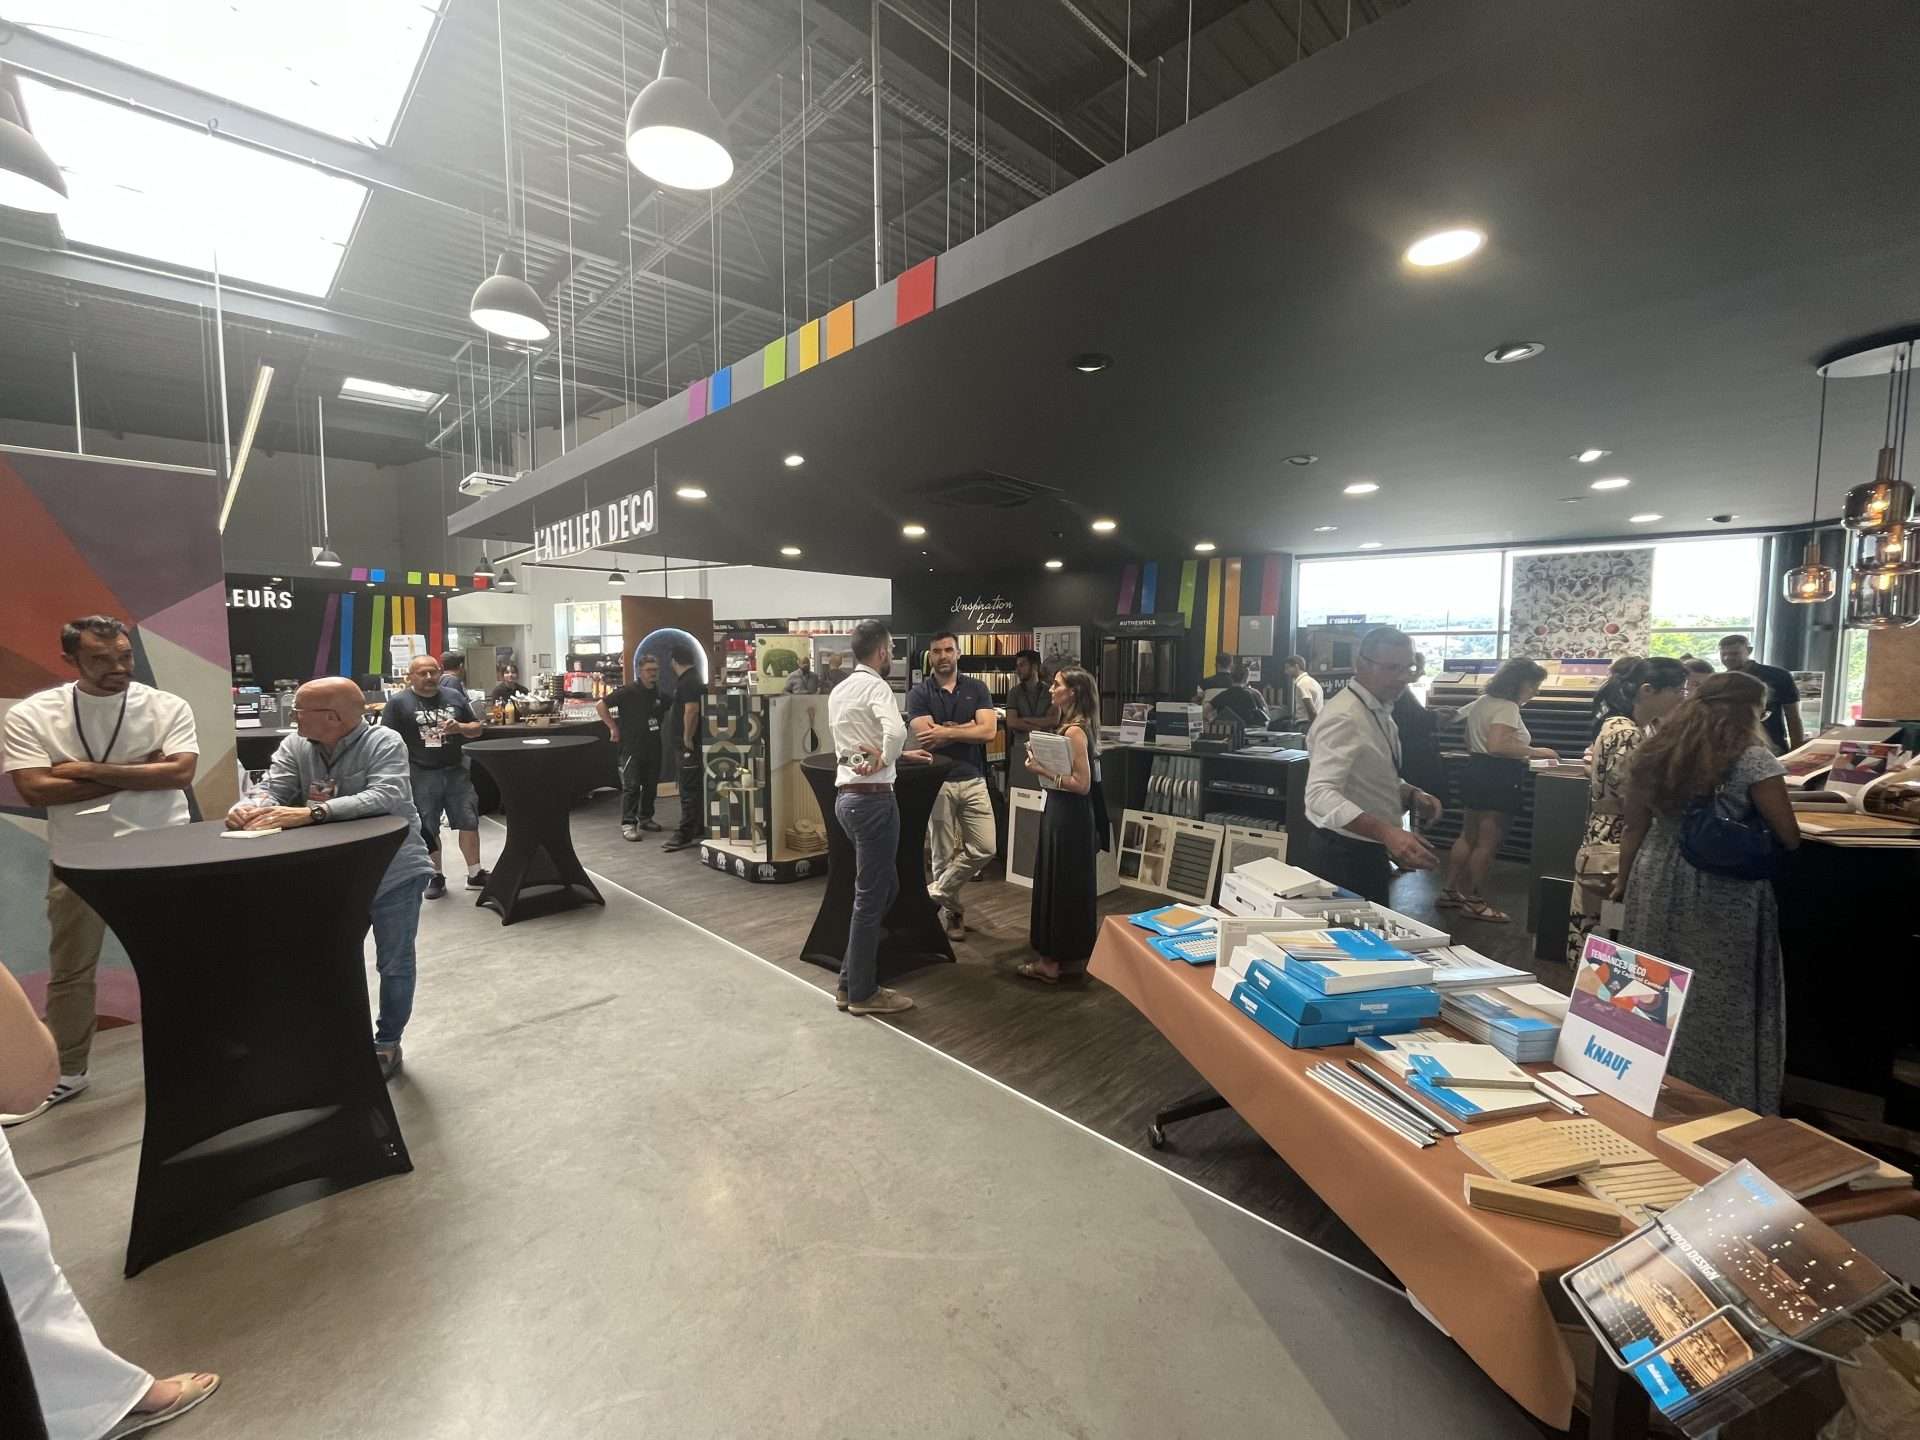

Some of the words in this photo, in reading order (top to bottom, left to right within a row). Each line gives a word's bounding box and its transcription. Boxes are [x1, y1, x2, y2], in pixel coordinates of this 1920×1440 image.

[535, 509, 601, 563] L'ATELIER
[226, 588, 292, 609] EURS
[951, 595, 1013, 620] Inspiration
[1584, 1034, 1632, 1080] KNAUF
[1663, 1223, 1692, 1252] WOOD
[1686, 1249, 1720, 1280] DESIGN
